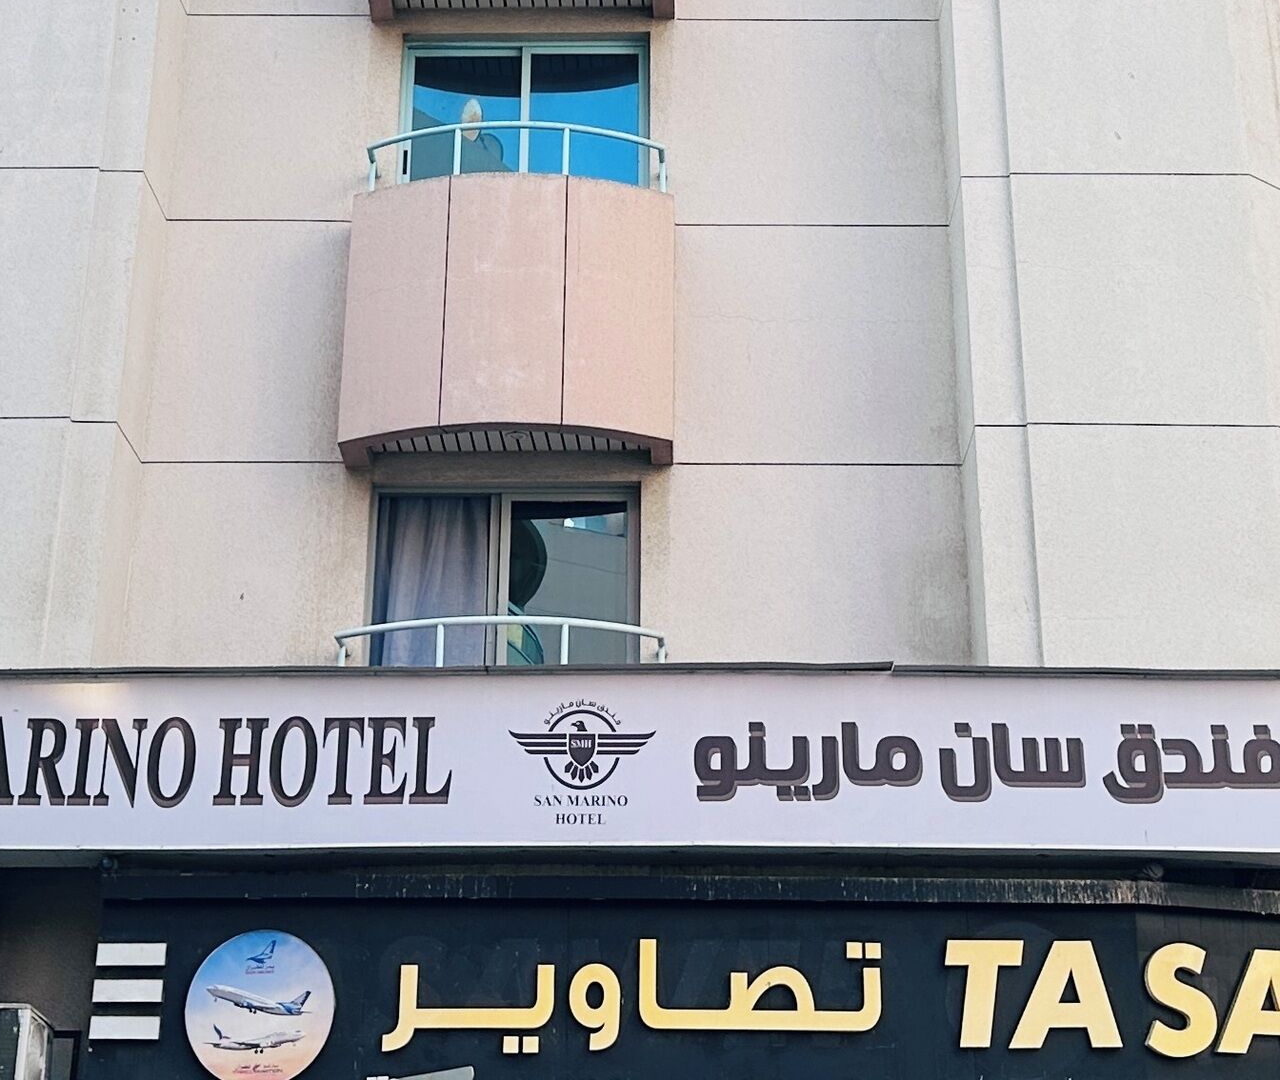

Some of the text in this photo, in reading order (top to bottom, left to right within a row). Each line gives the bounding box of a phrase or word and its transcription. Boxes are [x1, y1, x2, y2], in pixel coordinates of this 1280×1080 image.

[212, 716, 452, 807] HOTEL
[570, 739, 593, 749] SMH
[694, 721, 924, 802] مارينو
[938, 722, 1086, 802] سان
[534, 795, 628, 806] SAN MARINO
[556, 814, 606, 824] HOTEL
[381, 938, 883, 1054] تصاوير
